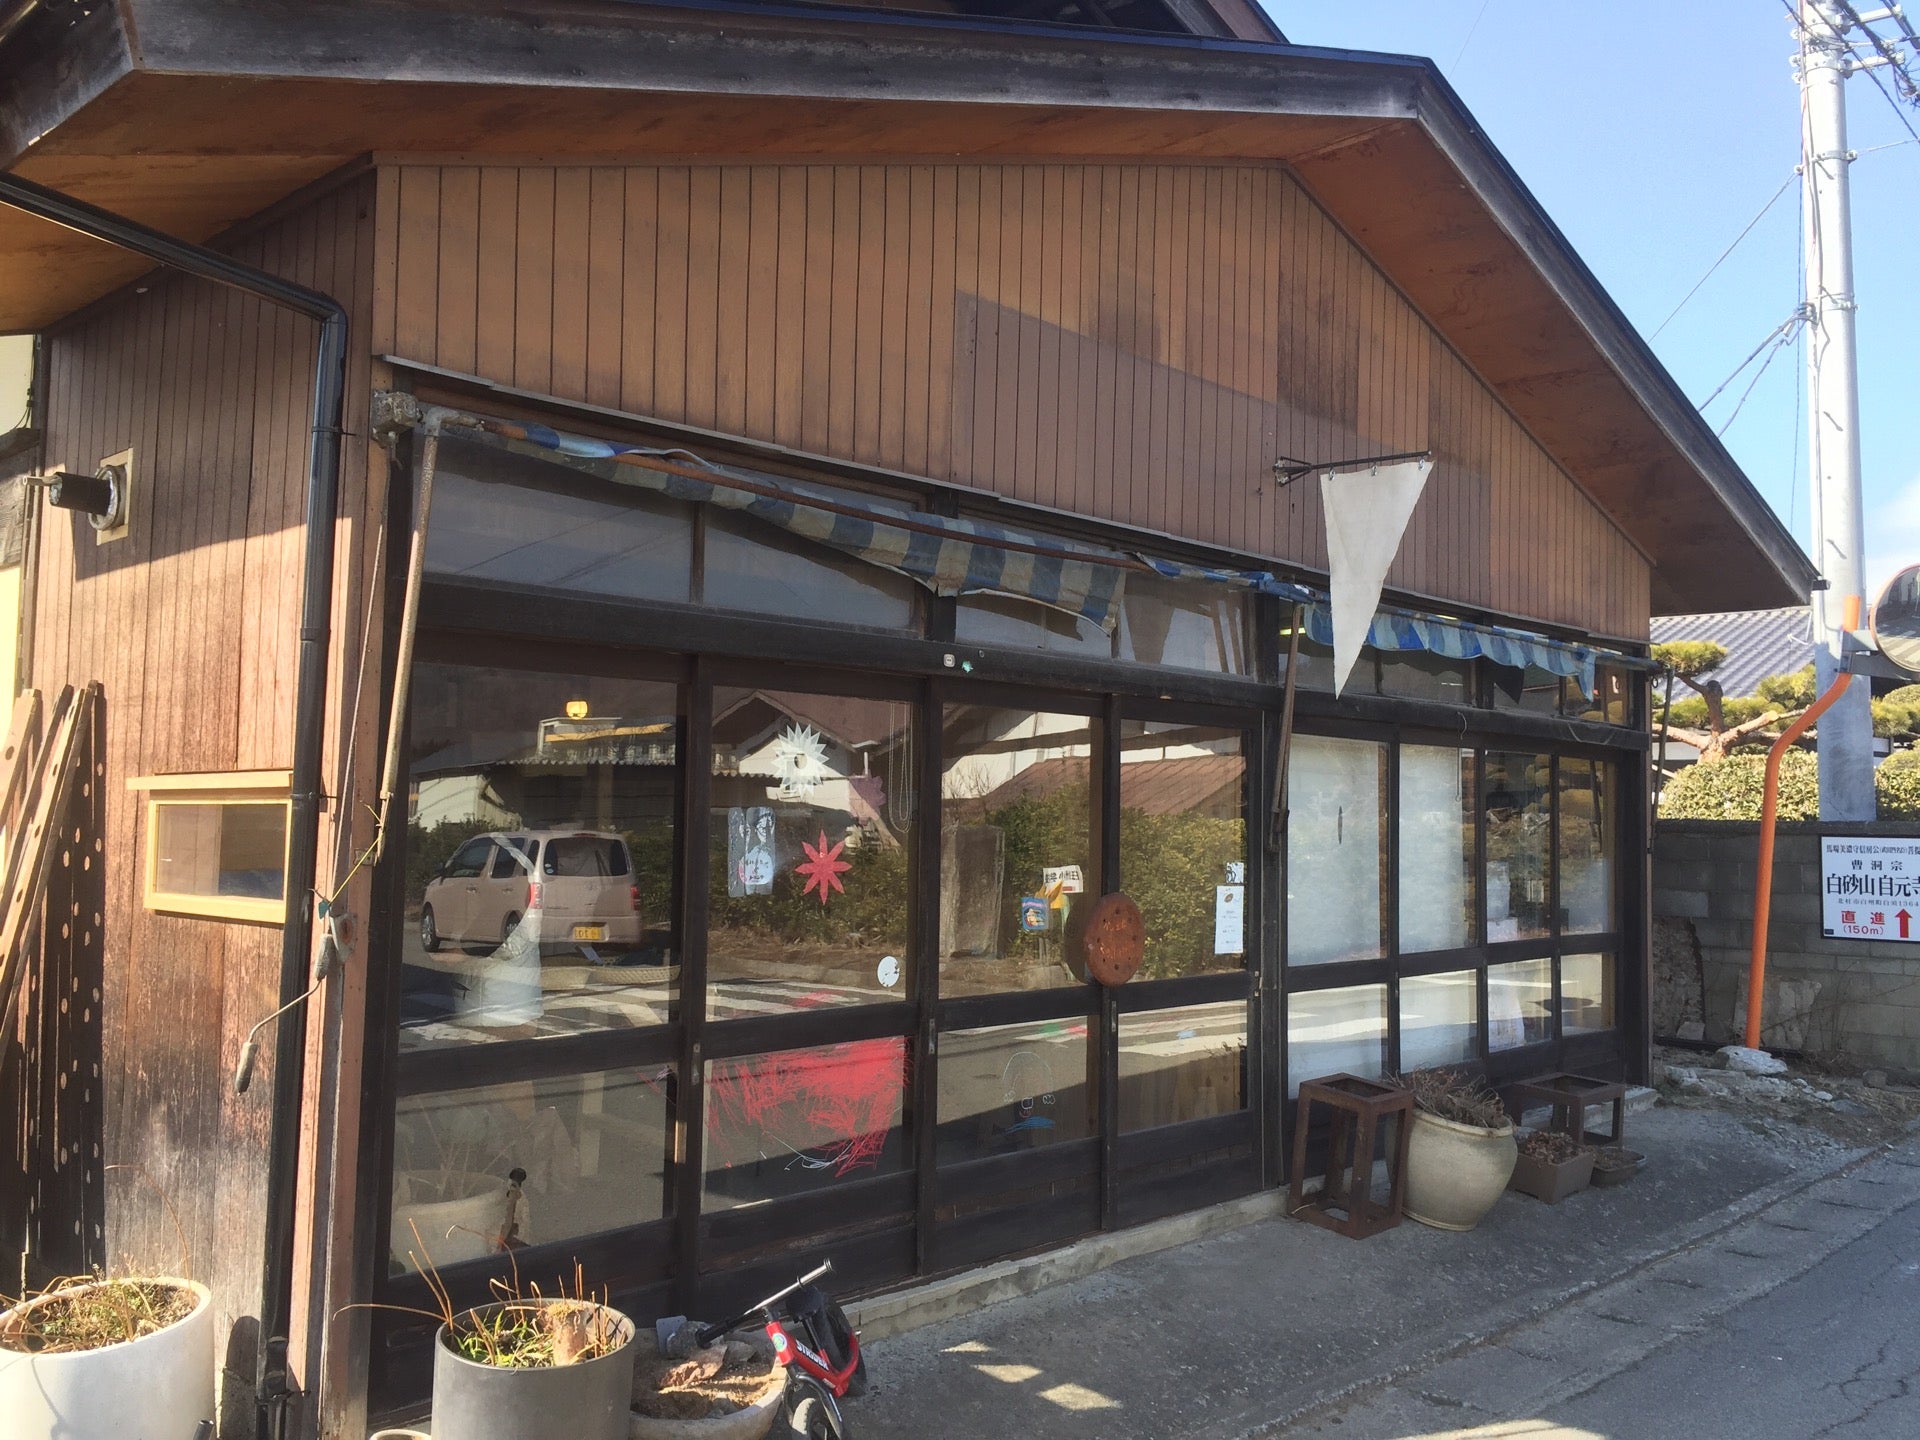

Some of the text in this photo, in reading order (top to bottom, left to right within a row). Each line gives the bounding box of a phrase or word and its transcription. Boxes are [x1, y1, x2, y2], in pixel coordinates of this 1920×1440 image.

[1851, 859, 1903, 871] 曹洞宗
[1841, 910, 1885, 925] 直進
[1843, 925, 1884, 935] (150m)
